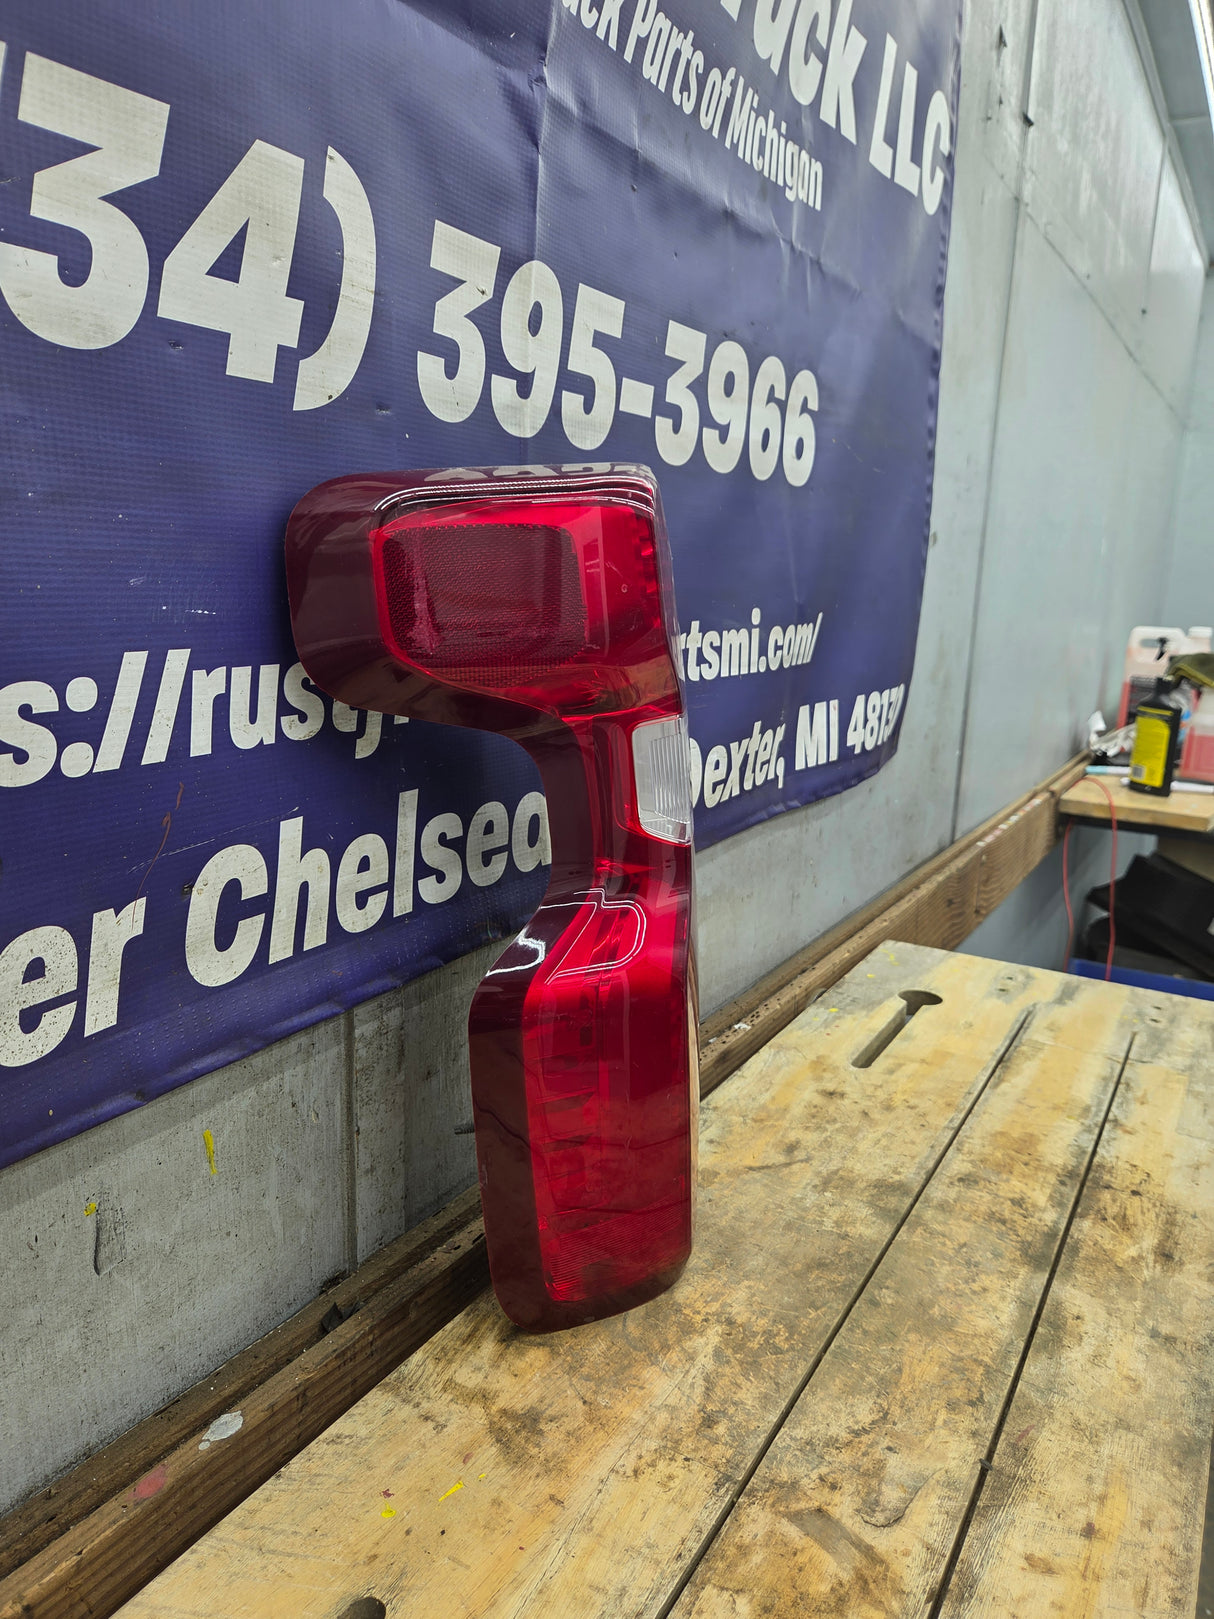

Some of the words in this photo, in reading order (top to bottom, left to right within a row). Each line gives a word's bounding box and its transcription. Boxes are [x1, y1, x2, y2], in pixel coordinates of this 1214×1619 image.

[623, 0, 705, 115] Parts
[699, 67, 737, 140] of
[724, 75, 824, 212] Michigan
[868, 32, 951, 216] LLC
[0, 42, 377, 412] 34)
[416, 219, 819, 487] 395-3966
[185, 788, 553, 988] Chelsea
[795, 698, 839, 771] MI
